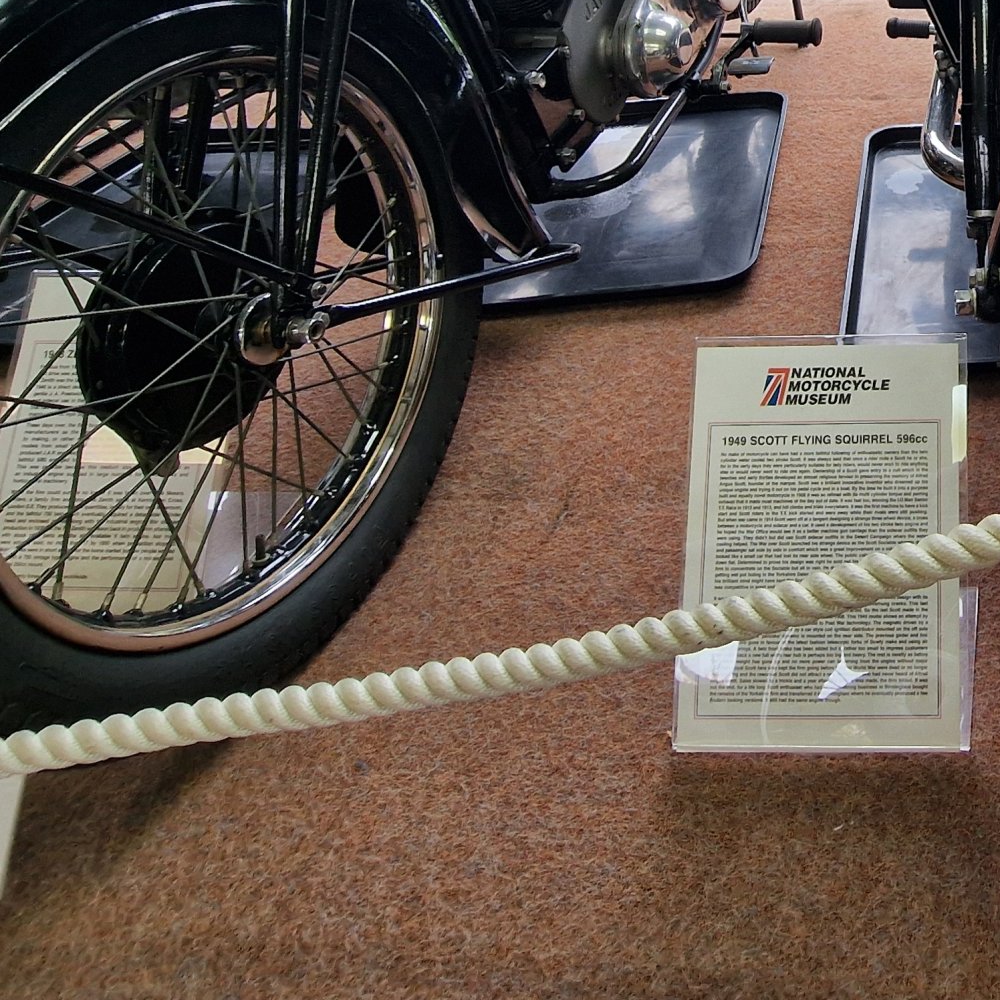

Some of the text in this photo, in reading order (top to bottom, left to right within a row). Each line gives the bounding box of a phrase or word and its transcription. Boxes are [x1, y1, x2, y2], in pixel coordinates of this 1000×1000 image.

[791, 367, 866, 379] NATIONAL
[788, 379, 891, 392] MOTORCYCLE
[785, 393, 852, 406] MUSEUM
[721, 433, 928, 446] 1949 SCOTT FLYING SQUIRREL 596cc
